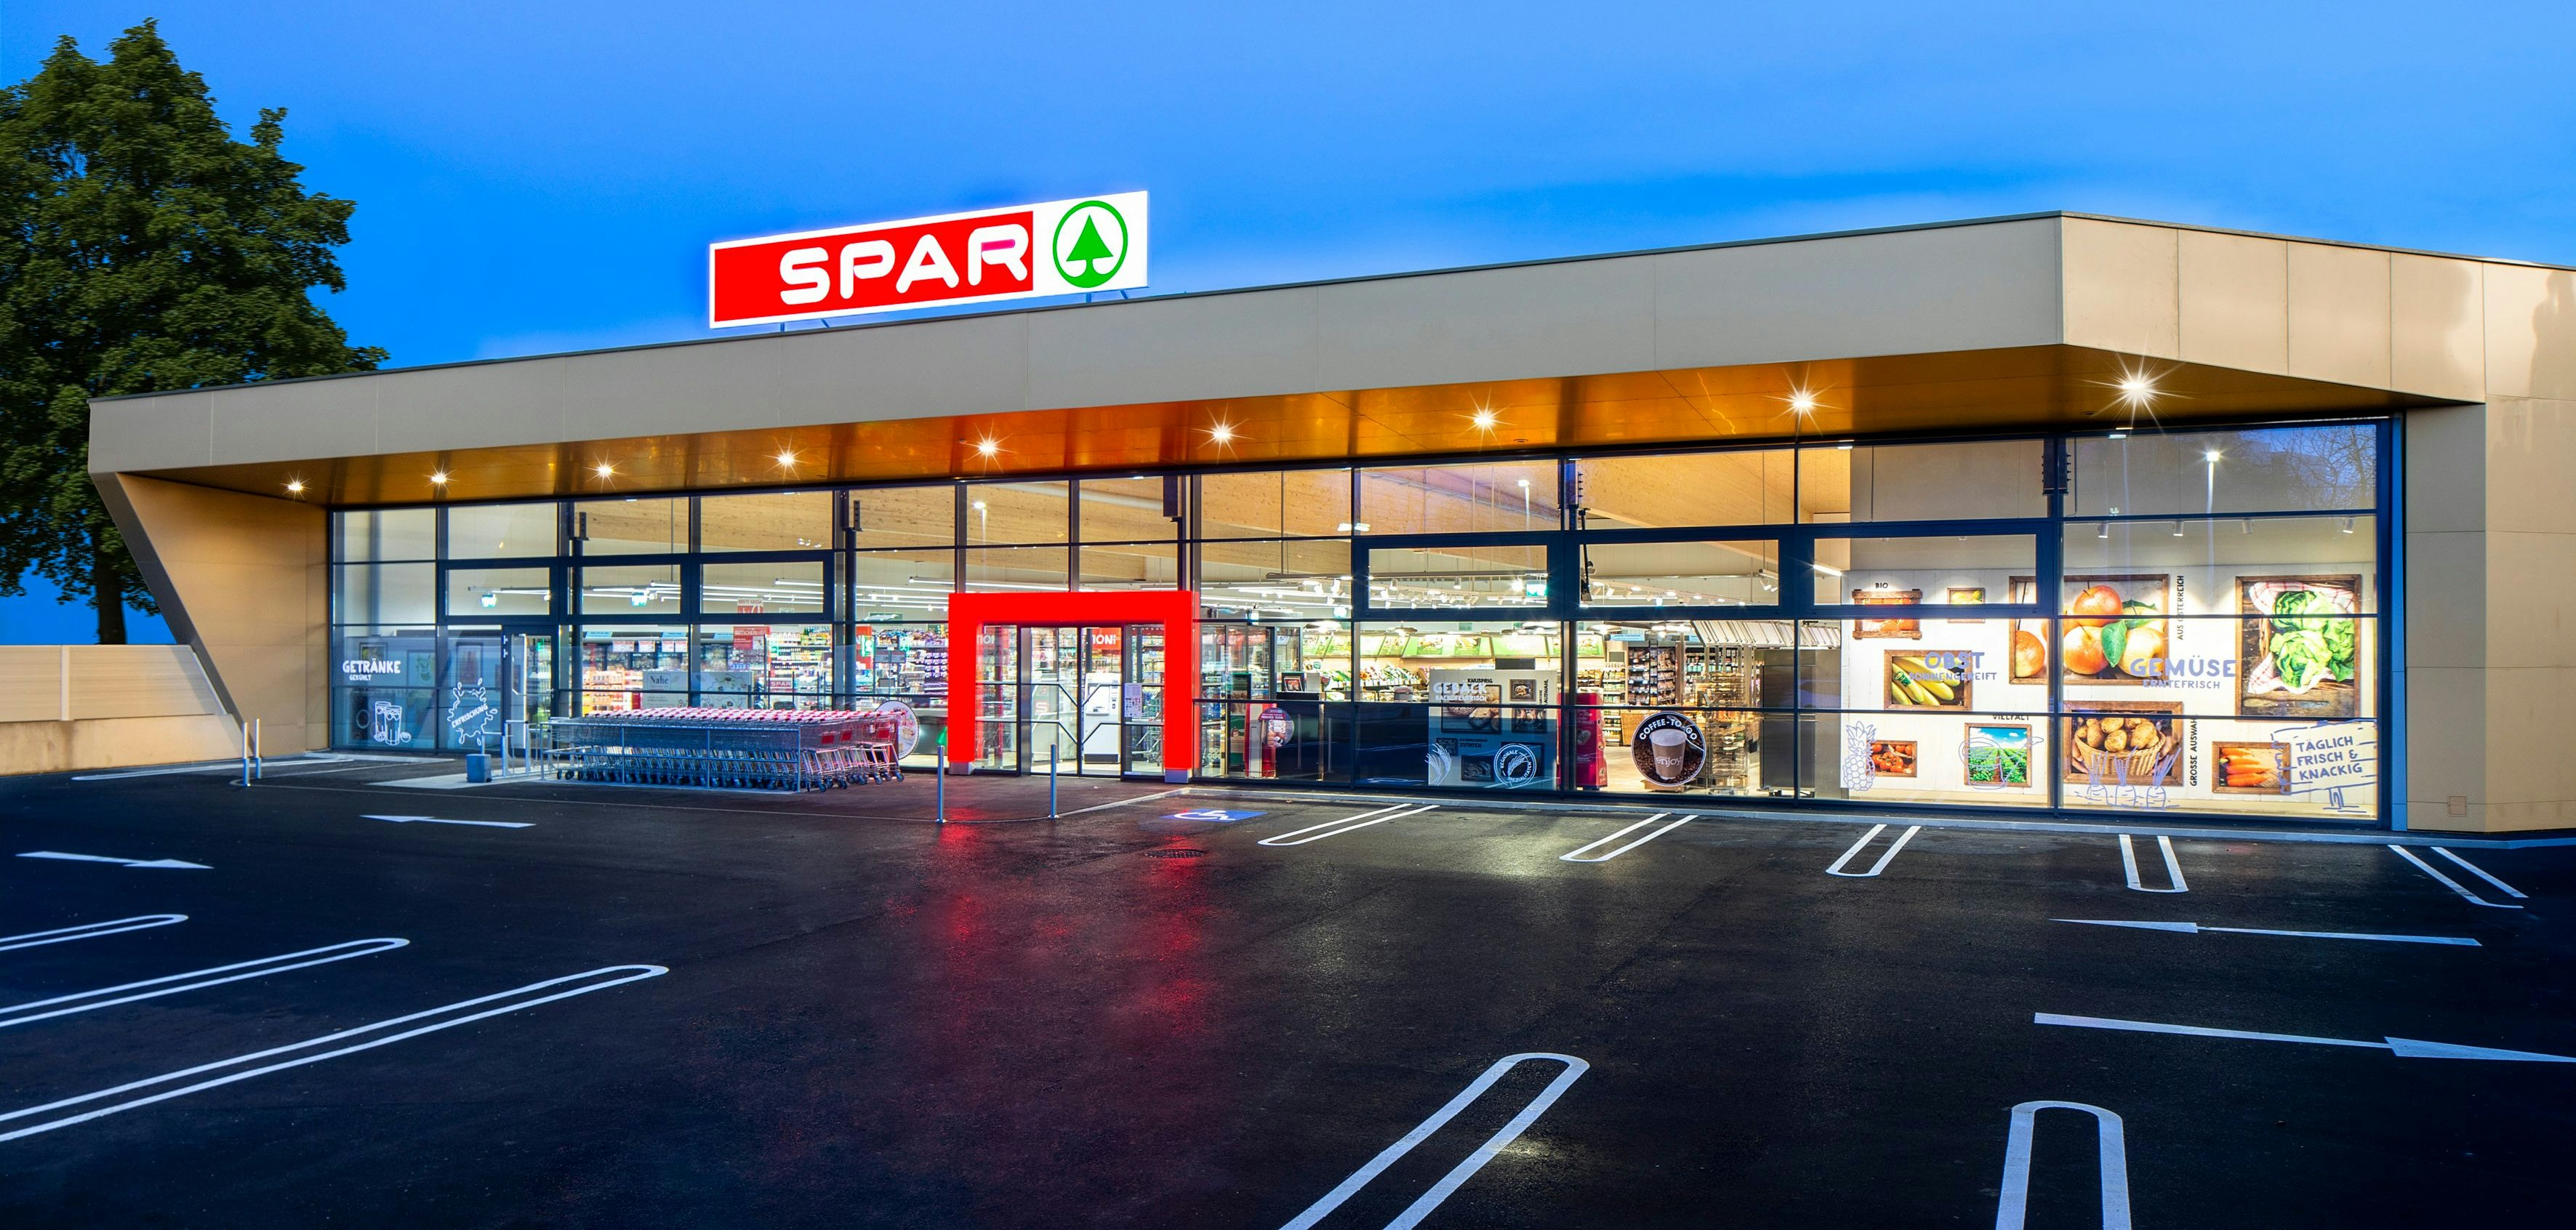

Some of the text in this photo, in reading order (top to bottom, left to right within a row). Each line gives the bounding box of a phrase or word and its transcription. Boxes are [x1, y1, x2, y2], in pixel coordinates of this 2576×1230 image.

[779, 223, 1029, 305] SPAR
[342, 658, 401, 674] GETRÄNKE
[1925, 651, 1985, 670] OBST
[2130, 655, 2237, 677] GEMÜSE
[1909, 672, 1997, 681] SONNENGEREIFT
[2142, 679, 2220, 689] ERNTEFRISCH
[1433, 680, 1488, 694] GEBÄCK
[2295, 736, 2354, 752] TÄGLICH
[1500, 750, 1518, 768] REGIONALE
[2297, 749, 2358, 766] FRISCH &
[2299, 763, 2363, 780] KNACKIG
